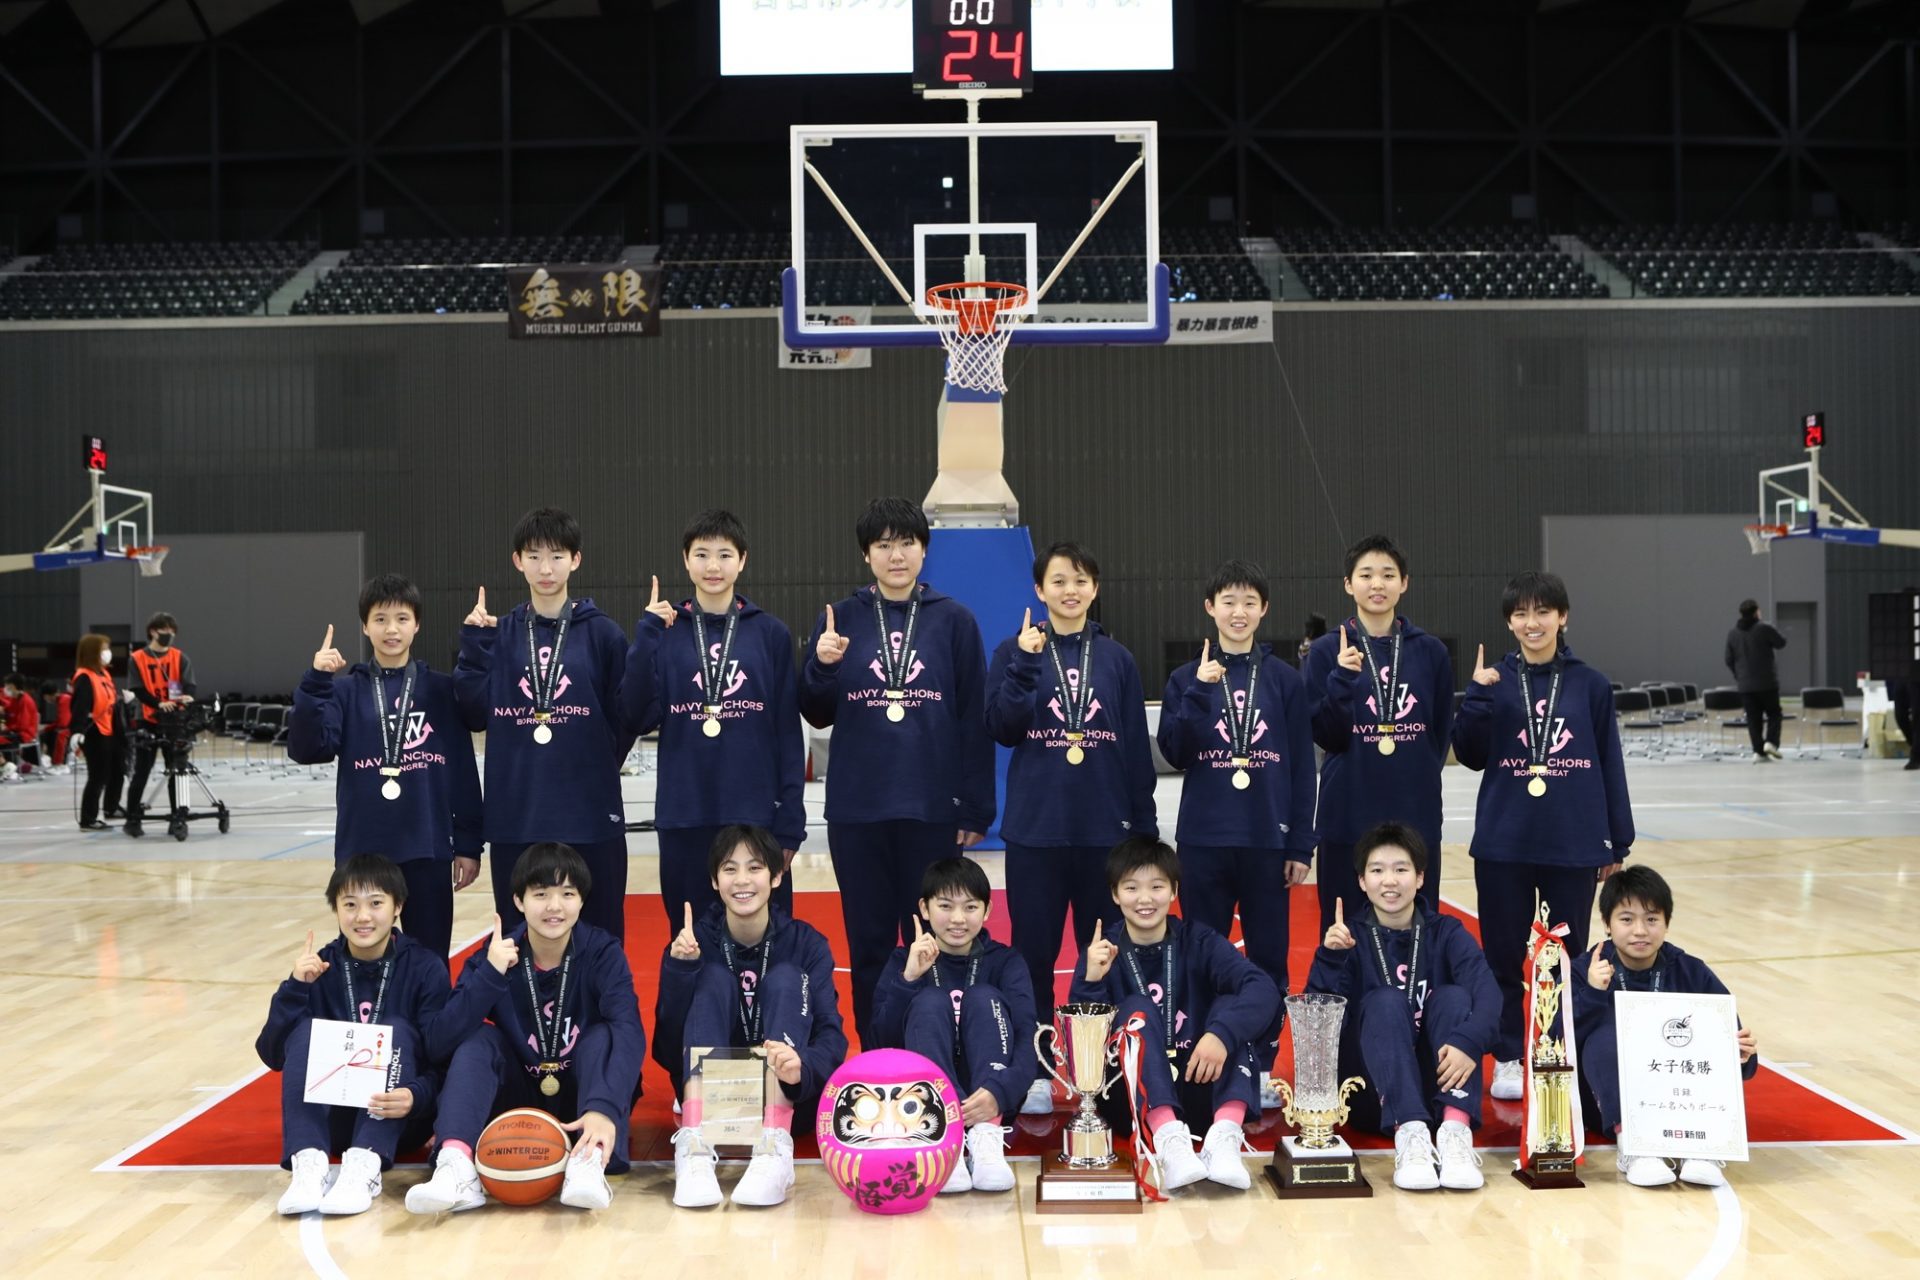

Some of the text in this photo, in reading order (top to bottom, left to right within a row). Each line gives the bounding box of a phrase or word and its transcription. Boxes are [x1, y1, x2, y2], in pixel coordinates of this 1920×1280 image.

[943, 31, 1023, 81] 24
[848, 689, 942, 701] NAVY ACHORS
[494, 705, 590, 716] NAVY ACHORS
[671, 702, 702, 713] NAVY
[1027, 729, 1057, 739] NAVY
[354, 756, 383, 769] NAV
[1499, 758, 1527, 768] AVY
[387, 1047, 401, 1093] ARYKNOLL
[1648, 1059, 1712, 1075] 女子優勝
[498, 1120, 542, 1132] molten
[1663, 1129, 1706, 1140] 朝日新聞
[532, 1146, 550, 1155] CUP
